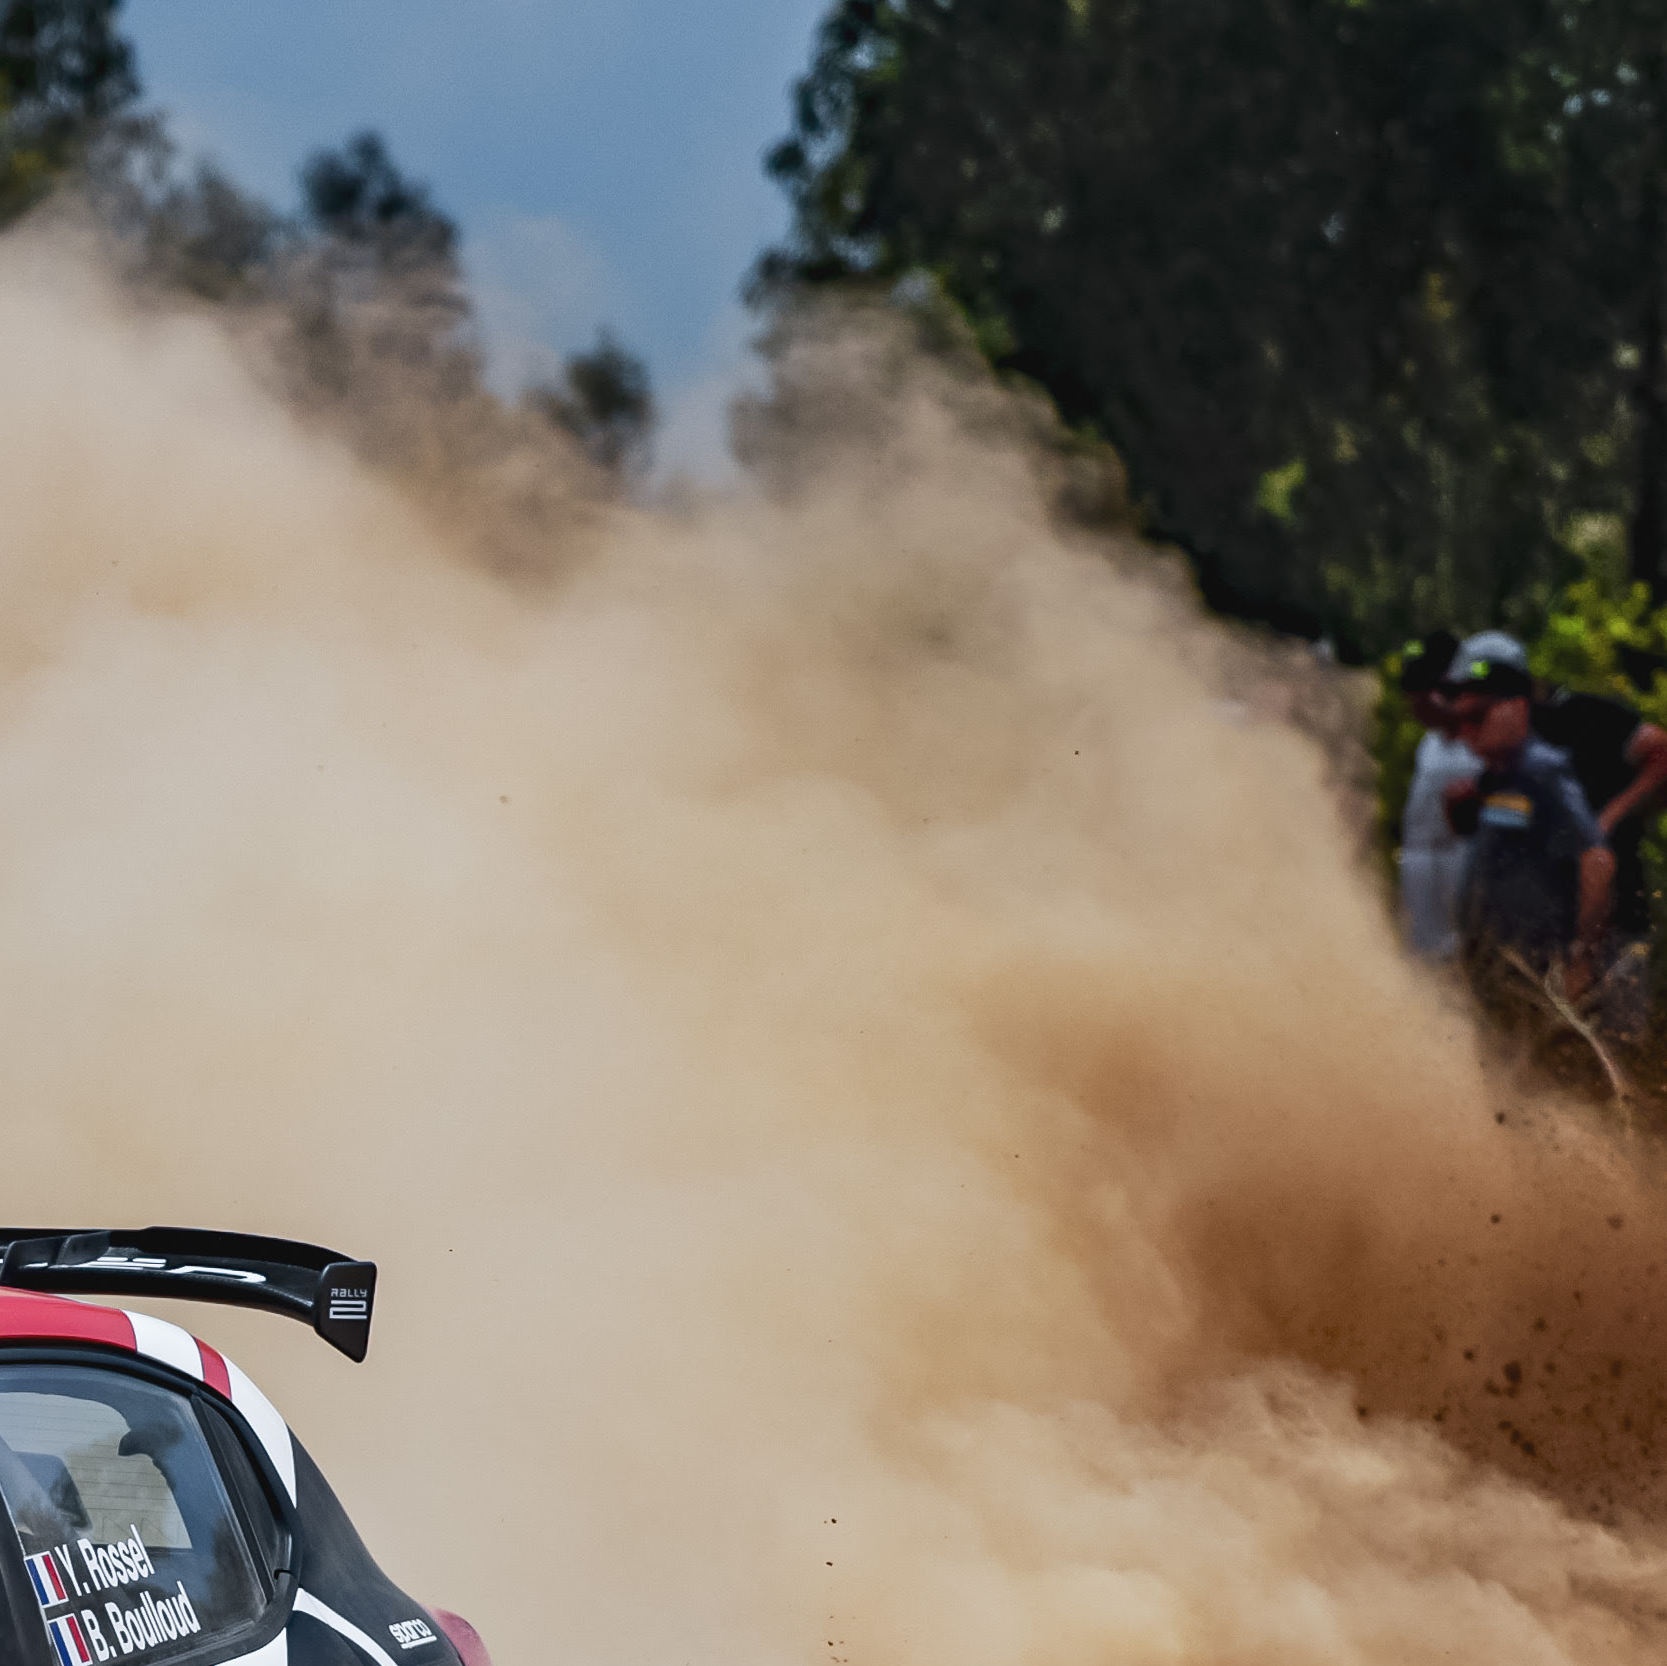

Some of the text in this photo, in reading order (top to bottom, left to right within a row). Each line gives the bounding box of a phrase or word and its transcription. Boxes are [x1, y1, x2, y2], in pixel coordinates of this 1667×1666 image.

[330, 1288, 367, 1298] RALLY
[54, 1524, 155, 1596] Y. Rossel
[81, 1580, 201, 1662] B. Boulloud
